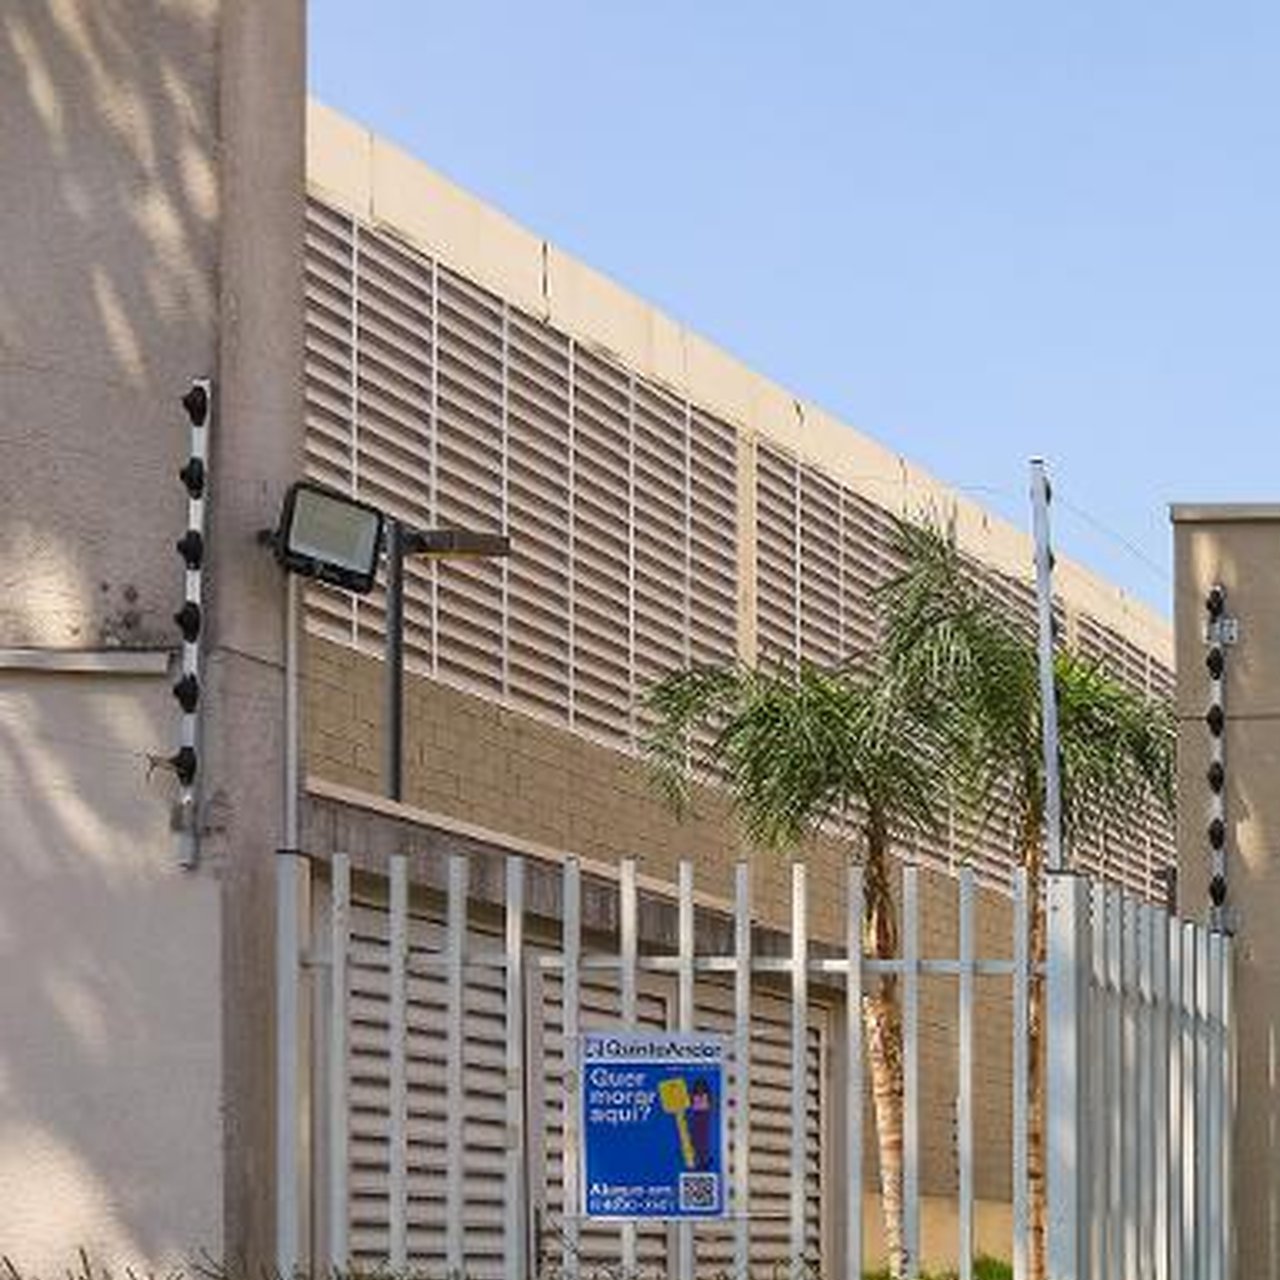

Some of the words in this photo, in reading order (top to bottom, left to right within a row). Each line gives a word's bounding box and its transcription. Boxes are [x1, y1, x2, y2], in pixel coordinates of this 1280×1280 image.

[606, 1039, 721, 1057] QuintoAndar
[590, 1067, 646, 1088] Quer
[589, 1090, 656, 1105] morar
[589, 1105, 652, 1126] aqui?
